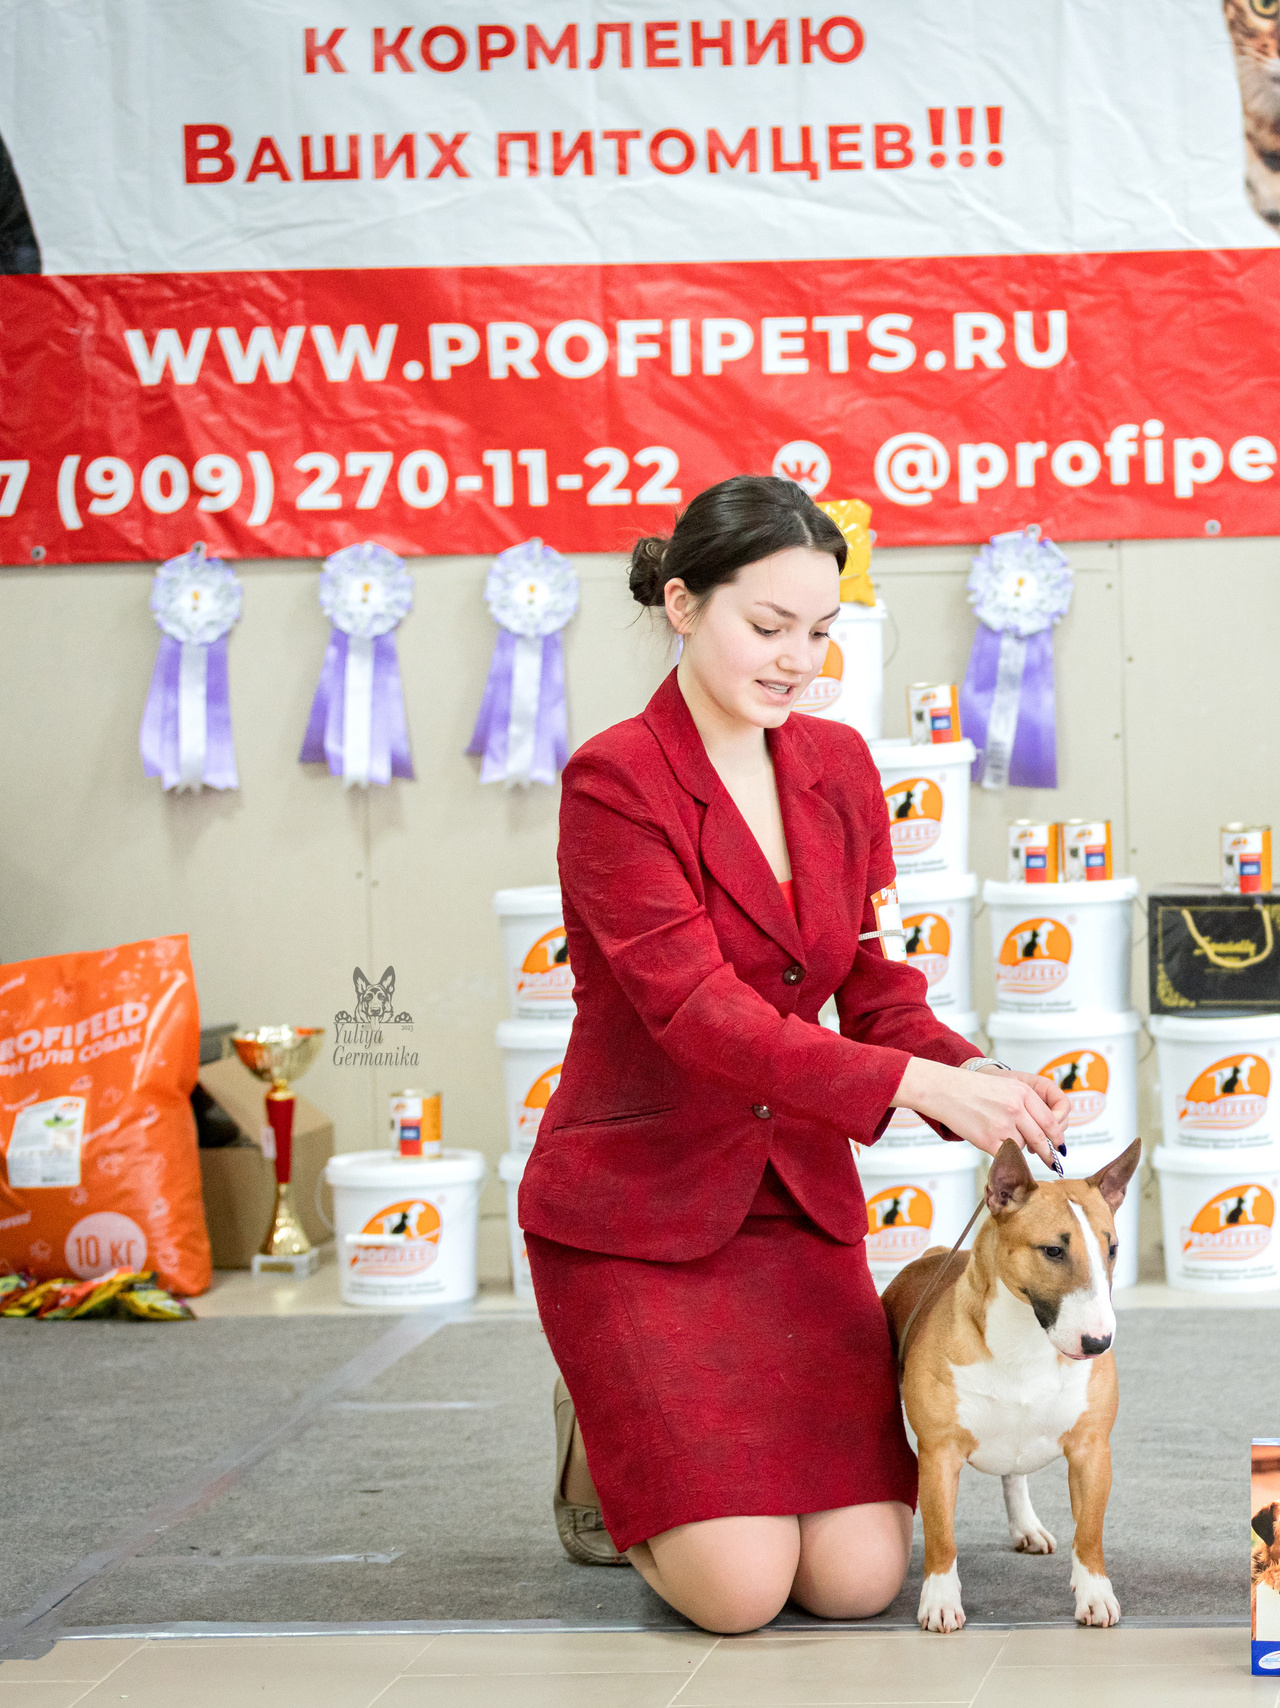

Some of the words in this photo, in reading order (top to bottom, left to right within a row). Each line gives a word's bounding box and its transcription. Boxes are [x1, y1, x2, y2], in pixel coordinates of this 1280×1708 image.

[306, 28, 345, 73] К
[374, 16, 865, 73] КОРМЛЕНИЮ
[184, 125, 469, 184] ВАШИХ
[498, 106, 1003, 181] ПИТОМЦЕВ!!!
[125, 310, 1068, 386] WWW.PROFIPETS.RU
[57, 451, 274, 530] (909)
[294, 447, 681, 510] 270-11-22
[0, 1002, 149, 1063] ROFIFEED
[75, 1235, 99, 1268] 10
